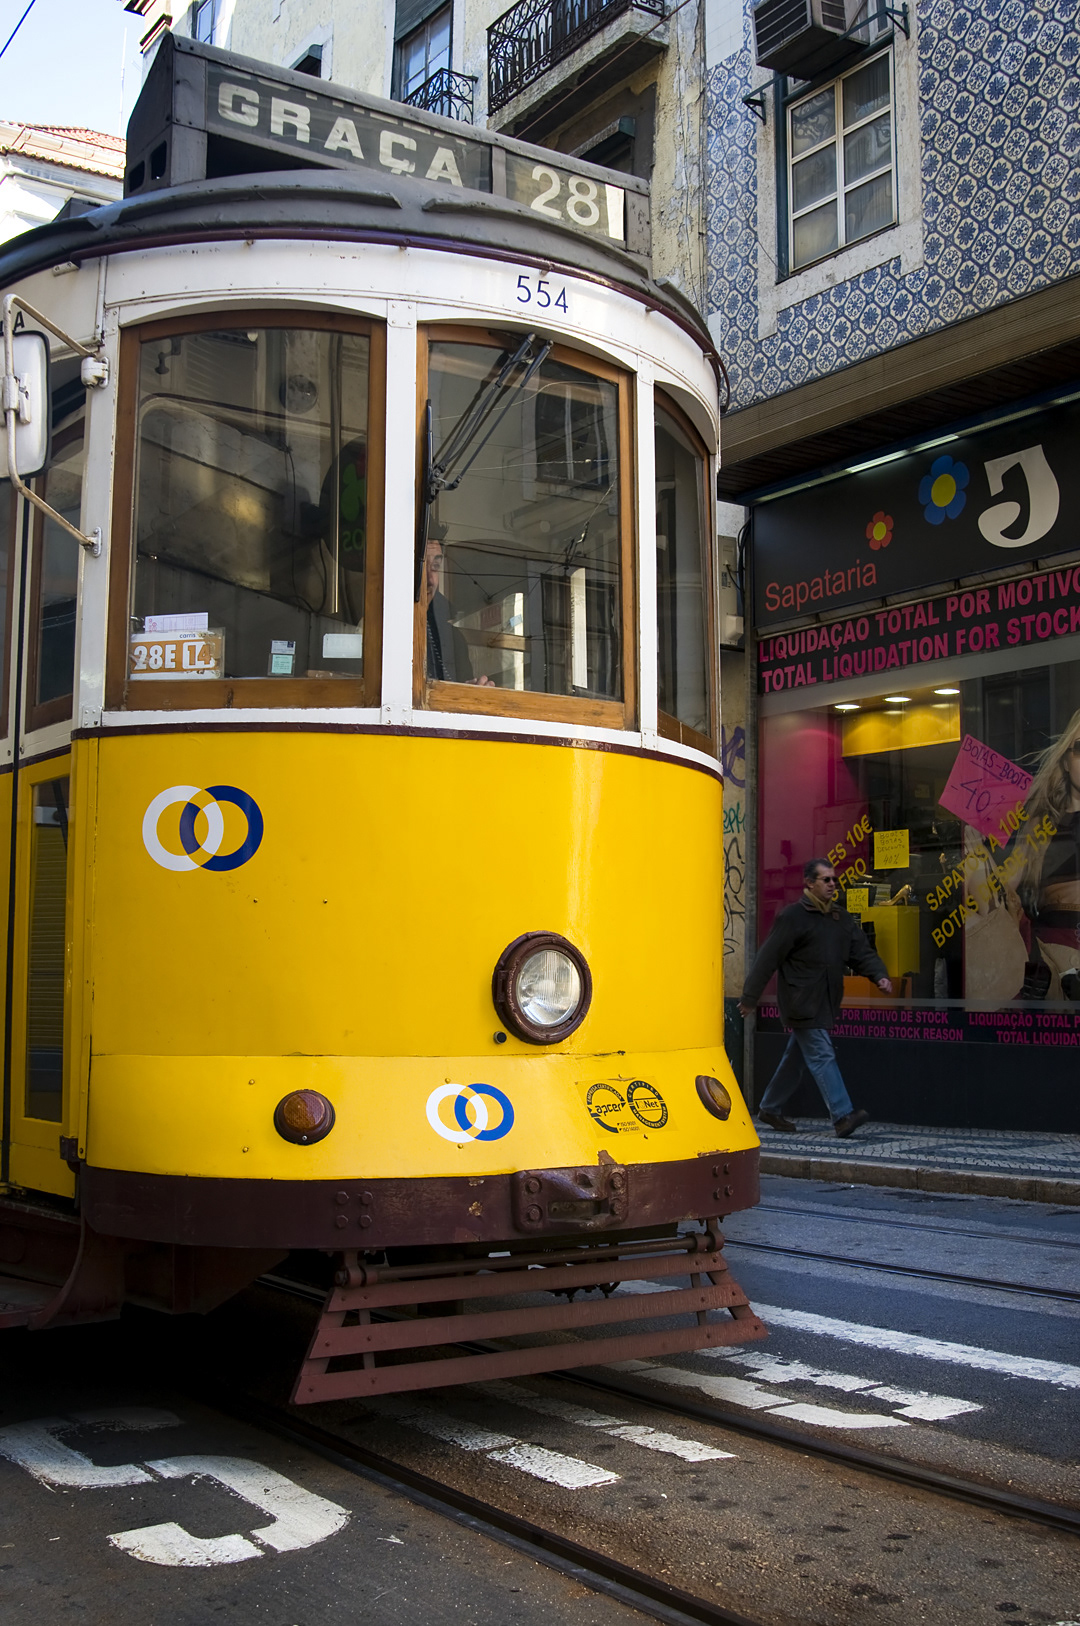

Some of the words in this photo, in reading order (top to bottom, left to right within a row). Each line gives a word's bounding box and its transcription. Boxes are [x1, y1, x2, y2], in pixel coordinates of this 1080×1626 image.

[218, 82, 464, 188] GRAÇA
[531, 165, 600, 227] 28
[517, 275, 568, 314] 554
[977, 444, 1060, 548] J
[765, 558, 877, 611] Sapataria
[875, 601, 939, 636] TOTAL
[946, 589, 991, 621] POR
[133, 644, 177, 670] 28E
[187, 644, 211, 666] 14
[762, 664, 816, 693] TOTAL
[822, 632, 949, 682] LIQUIDATION
[956, 623, 1000, 655] FOR
[846, 814, 873, 848] 10€
[925, 845, 988, 912] SAPATOS
[988, 833, 1002, 852] A
[999, 800, 1030, 838] 10€
[931, 894, 980, 948] BOTAS
[977, 847, 1028, 902] DESDE
[1025, 814, 1058, 852] 15€
[842, 1009, 860, 1021] POR
[862, 1010, 898, 1022] MOTIVO
[900, 1011, 913, 1022] DE
[915, 1011, 949, 1024] STOCK
[868, 1025, 886, 1037] FOR
[888, 1026, 920, 1039] STOCK
[923, 1028, 963, 1041] REASON
[969, 1012, 1033, 1029] LIQUIDAÇÃO
[1036, 1014, 1071, 1028] TOTAL
[996, 1031, 1030, 1044] TOTAL
[595, 1104, 622, 1117] apcer
